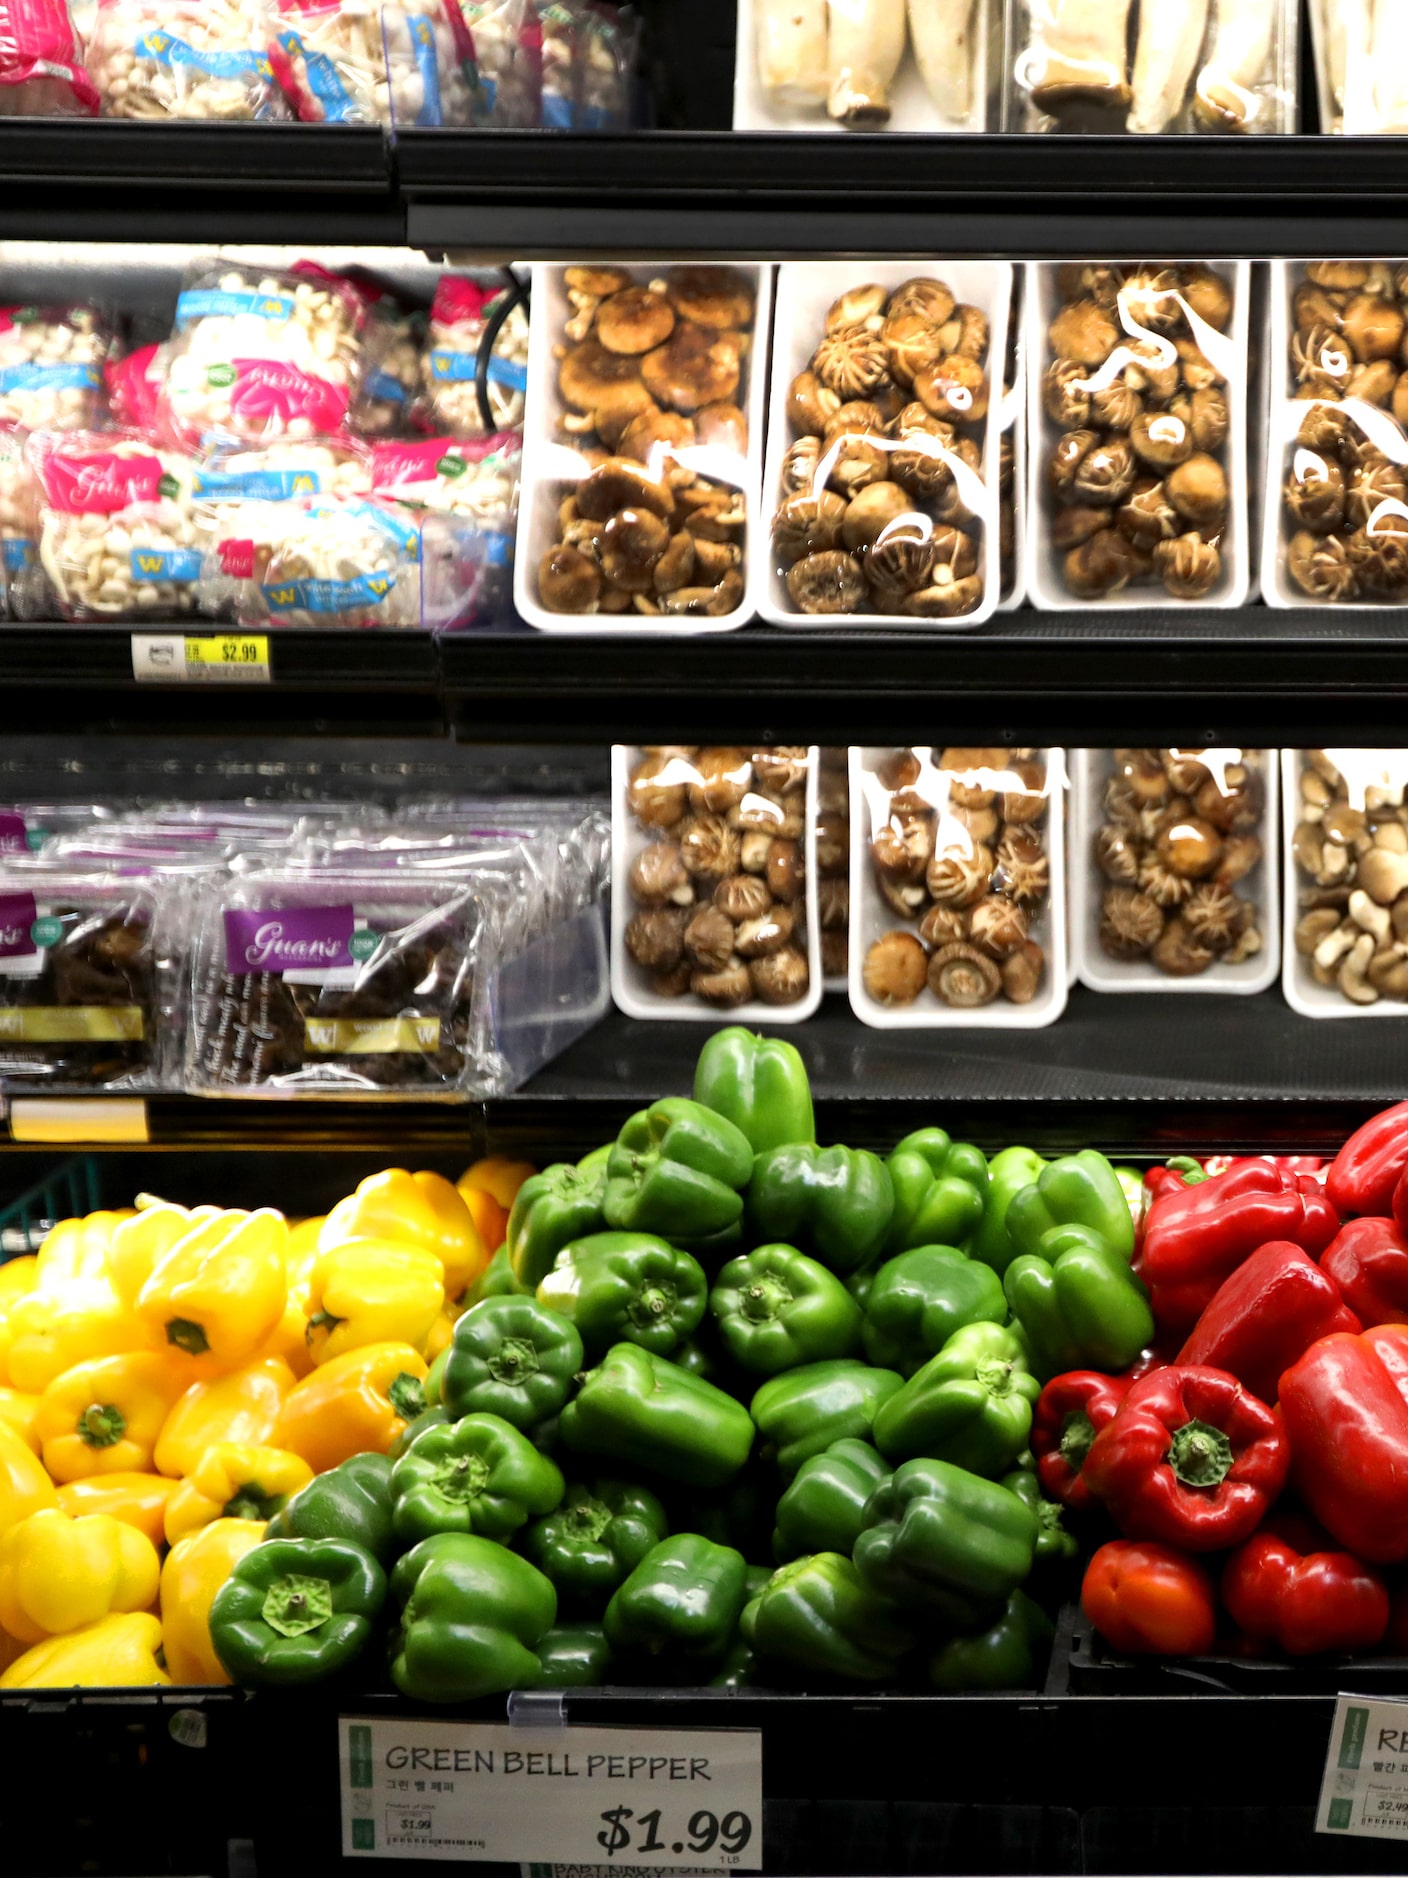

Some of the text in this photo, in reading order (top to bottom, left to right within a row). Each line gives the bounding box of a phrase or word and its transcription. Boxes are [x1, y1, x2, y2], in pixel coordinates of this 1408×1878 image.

[138, 556, 163, 572] W
[222, 643, 257, 662] $2.99
[245, 921, 341, 965] Guan's
[308, 1026, 333, 1045] W
[416, 1026, 437, 1045] W
[385, 1746, 494, 1773] GREEN
[503, 1751, 579, 1776] BELL
[587, 1754, 712, 1781] PEPPER
[1377, 1800, 1408, 1812] $2.49
[400, 1819, 431, 1830] $1.99
[597, 1804, 752, 1856] $1.99
[727, 1856, 740, 1864] LB
